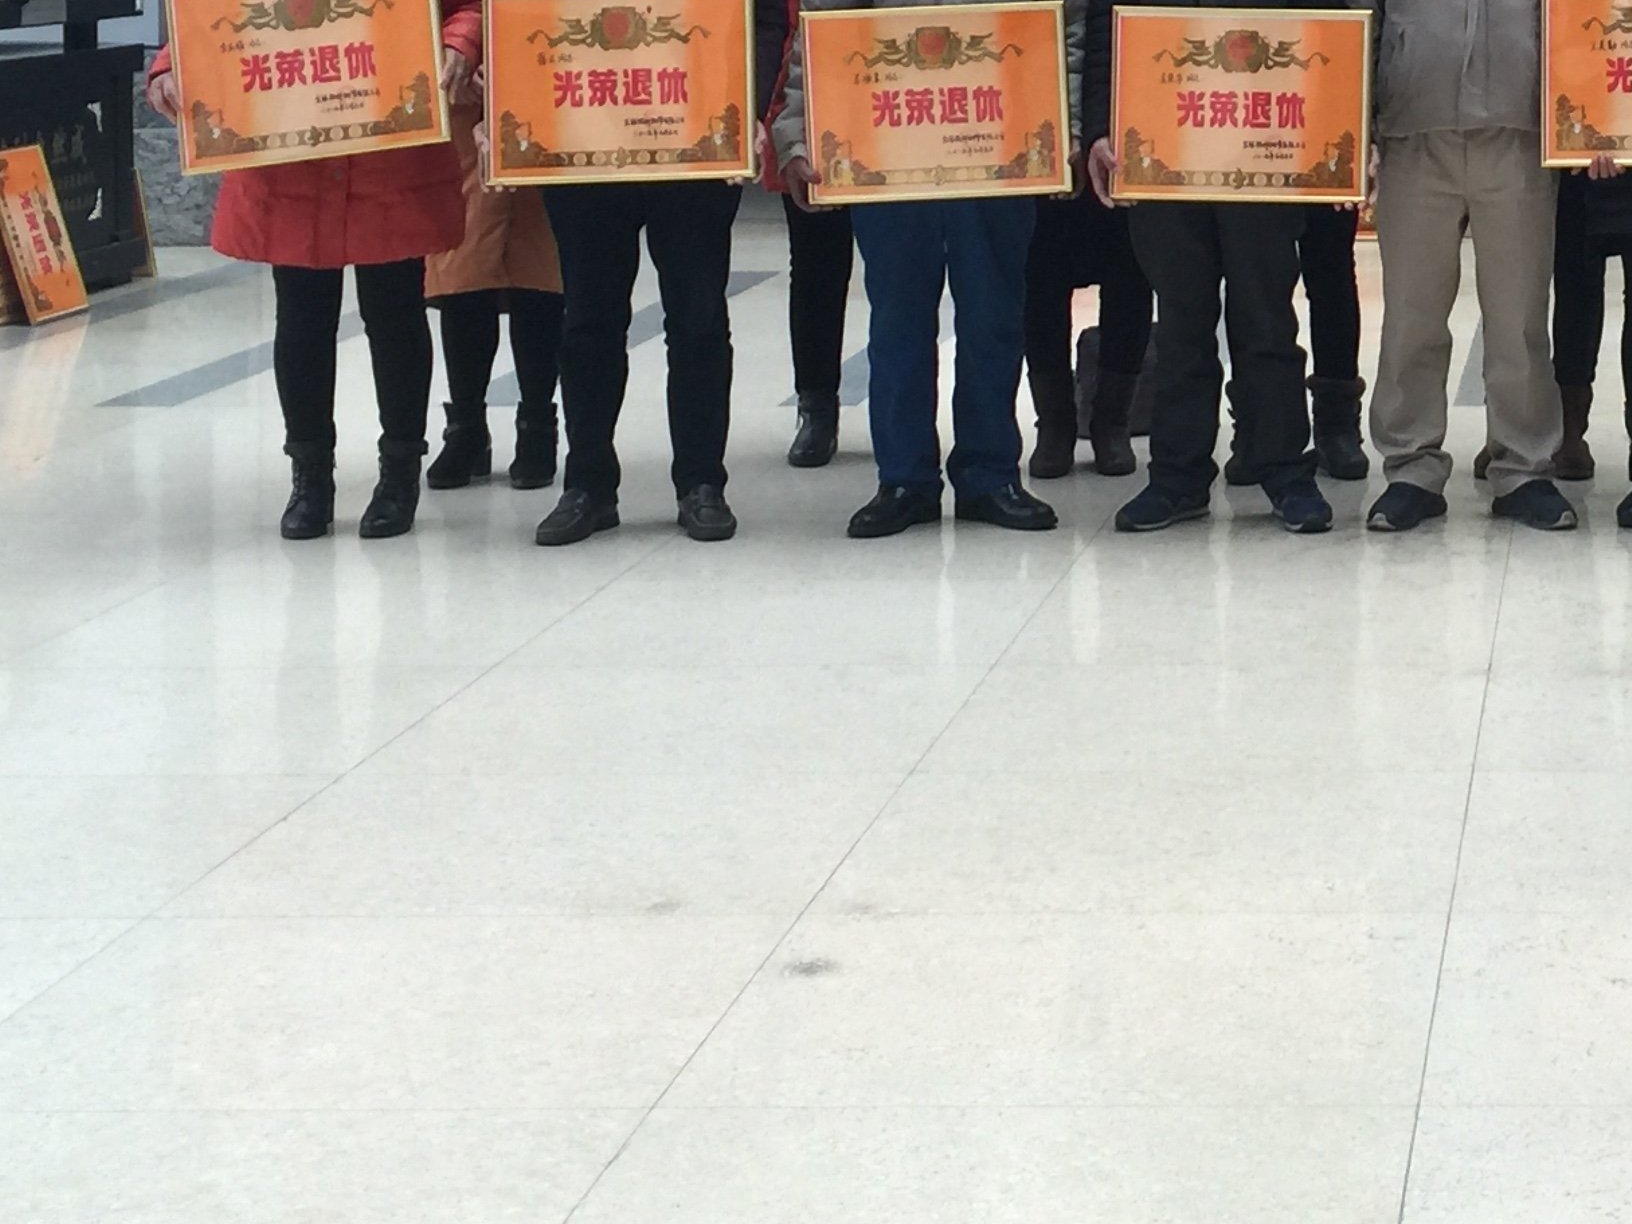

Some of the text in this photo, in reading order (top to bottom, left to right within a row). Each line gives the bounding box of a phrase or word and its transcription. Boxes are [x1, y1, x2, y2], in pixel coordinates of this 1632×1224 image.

[241, 43, 375, 91] 光荣退休
[556, 68, 688, 109] 光荣退休
[874, 86, 1002, 128] 光荣退休
[1179, 91, 1303, 129] 光荣退休
